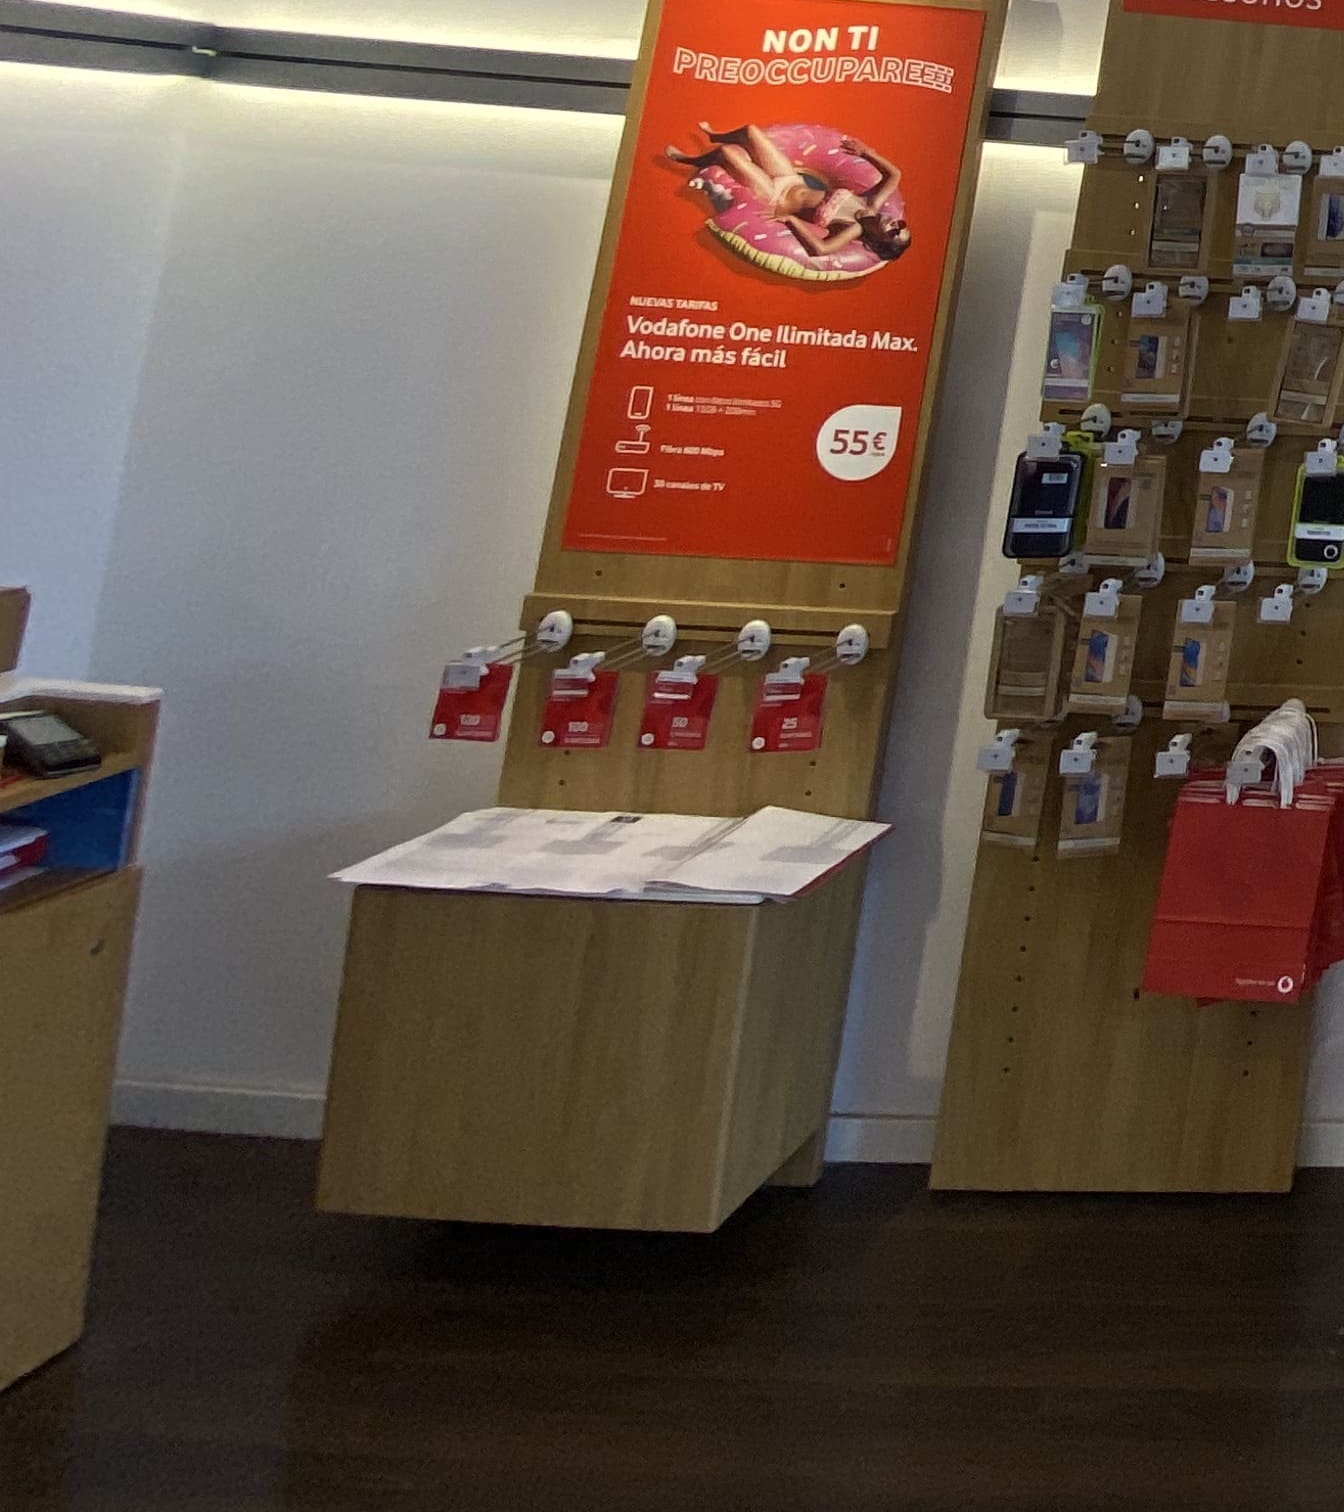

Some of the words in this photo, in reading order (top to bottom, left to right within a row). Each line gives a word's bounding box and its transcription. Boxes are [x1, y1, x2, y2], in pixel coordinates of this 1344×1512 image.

[762, 27, 838, 54] NON
[848, 25, 880, 52] TI
[629, 295, 674, 309] NUEVAS
[675, 299, 719, 312] TARIFAS
[627, 315, 725, 340] Vodafone
[729, 321, 772, 342] One
[776, 324, 867, 349] Ilimitada
[871, 330, 918, 353] Max.
[619, 340, 685, 363] Ahora
[689, 345, 737, 366] más
[740, 346, 787, 369] fácil
[829, 429, 888, 456] 55€
[700, 482, 712, 491] de
[712, 482, 726, 491] TV
